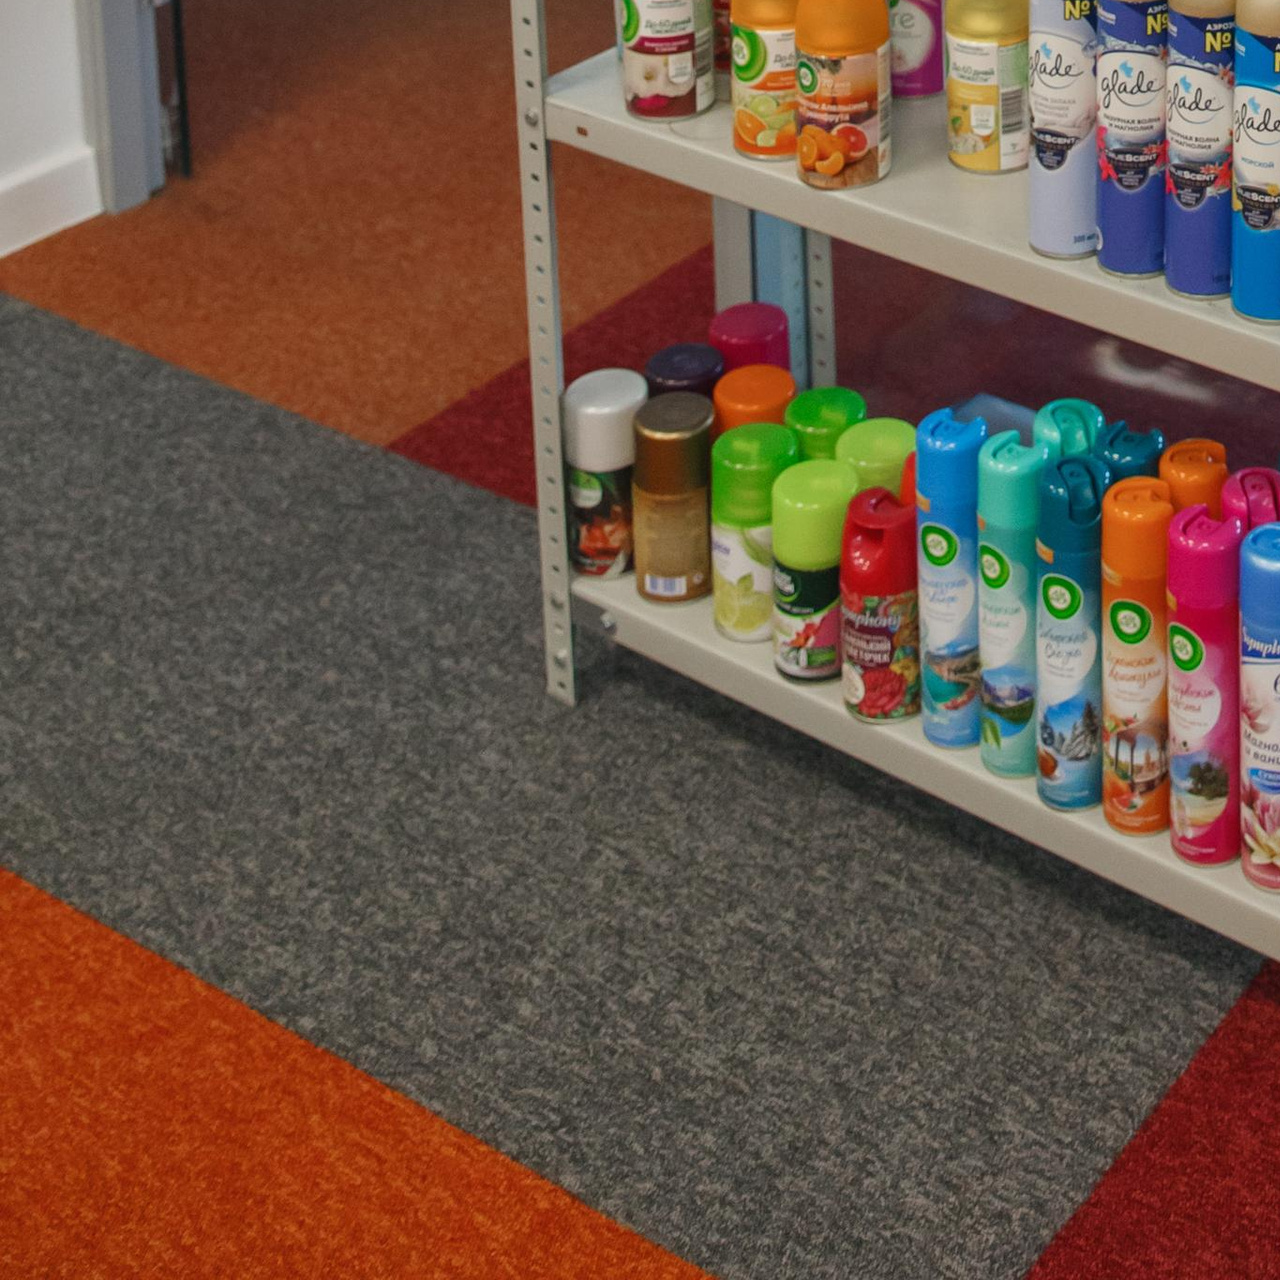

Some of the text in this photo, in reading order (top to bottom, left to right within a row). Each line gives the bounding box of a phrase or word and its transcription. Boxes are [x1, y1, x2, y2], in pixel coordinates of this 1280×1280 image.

[1101, 69, 1166, 109] glade
[1137, 116, 1161, 125] ВОЛНА
[1114, 123, 1154, 133] МАГНОЛИЯ
[1194, 135, 1220, 143] ВОЛНА
[1241, 157, 1275, 169] МОРСКОЙ
